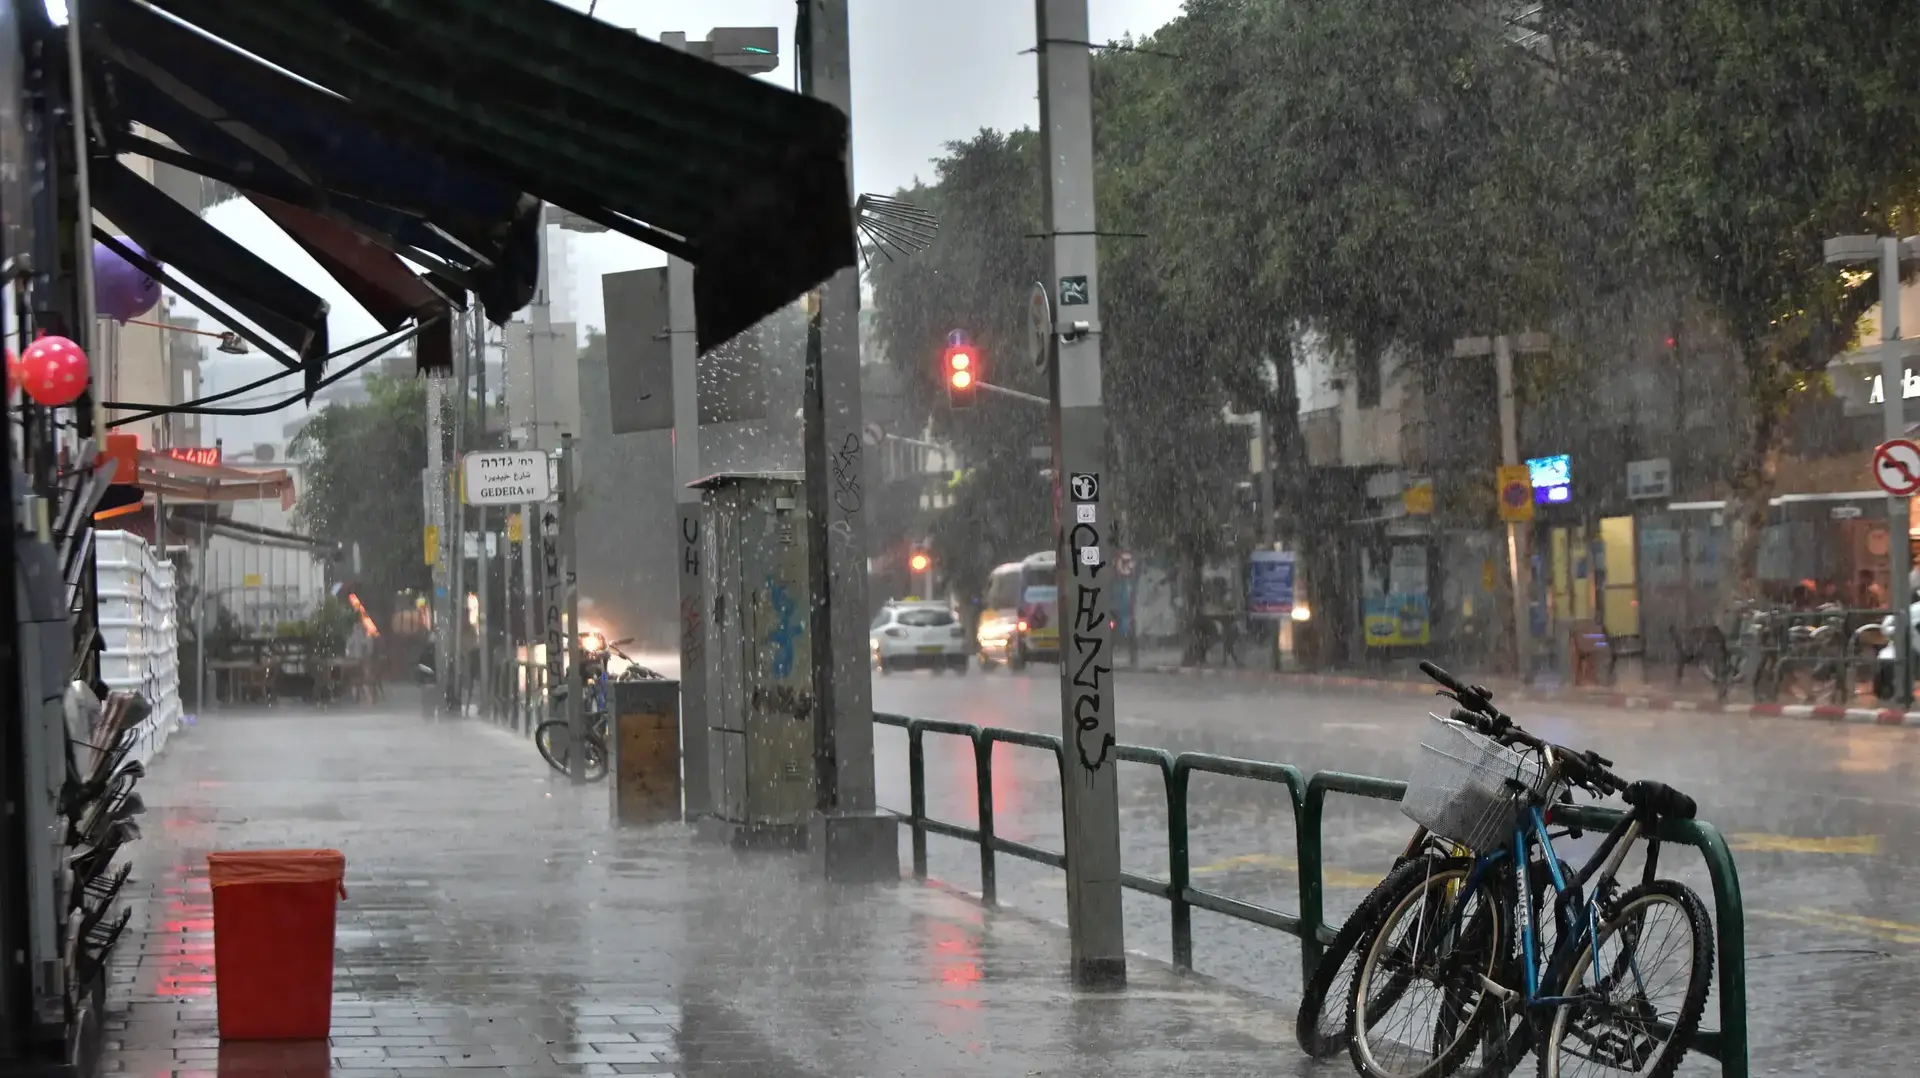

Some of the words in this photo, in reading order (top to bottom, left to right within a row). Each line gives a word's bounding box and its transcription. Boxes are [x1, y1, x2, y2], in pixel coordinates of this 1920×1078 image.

[481, 456, 513, 468] גדרה
[481, 486, 524, 498] GEDERA
[1516, 867, 1529, 926] POWER
